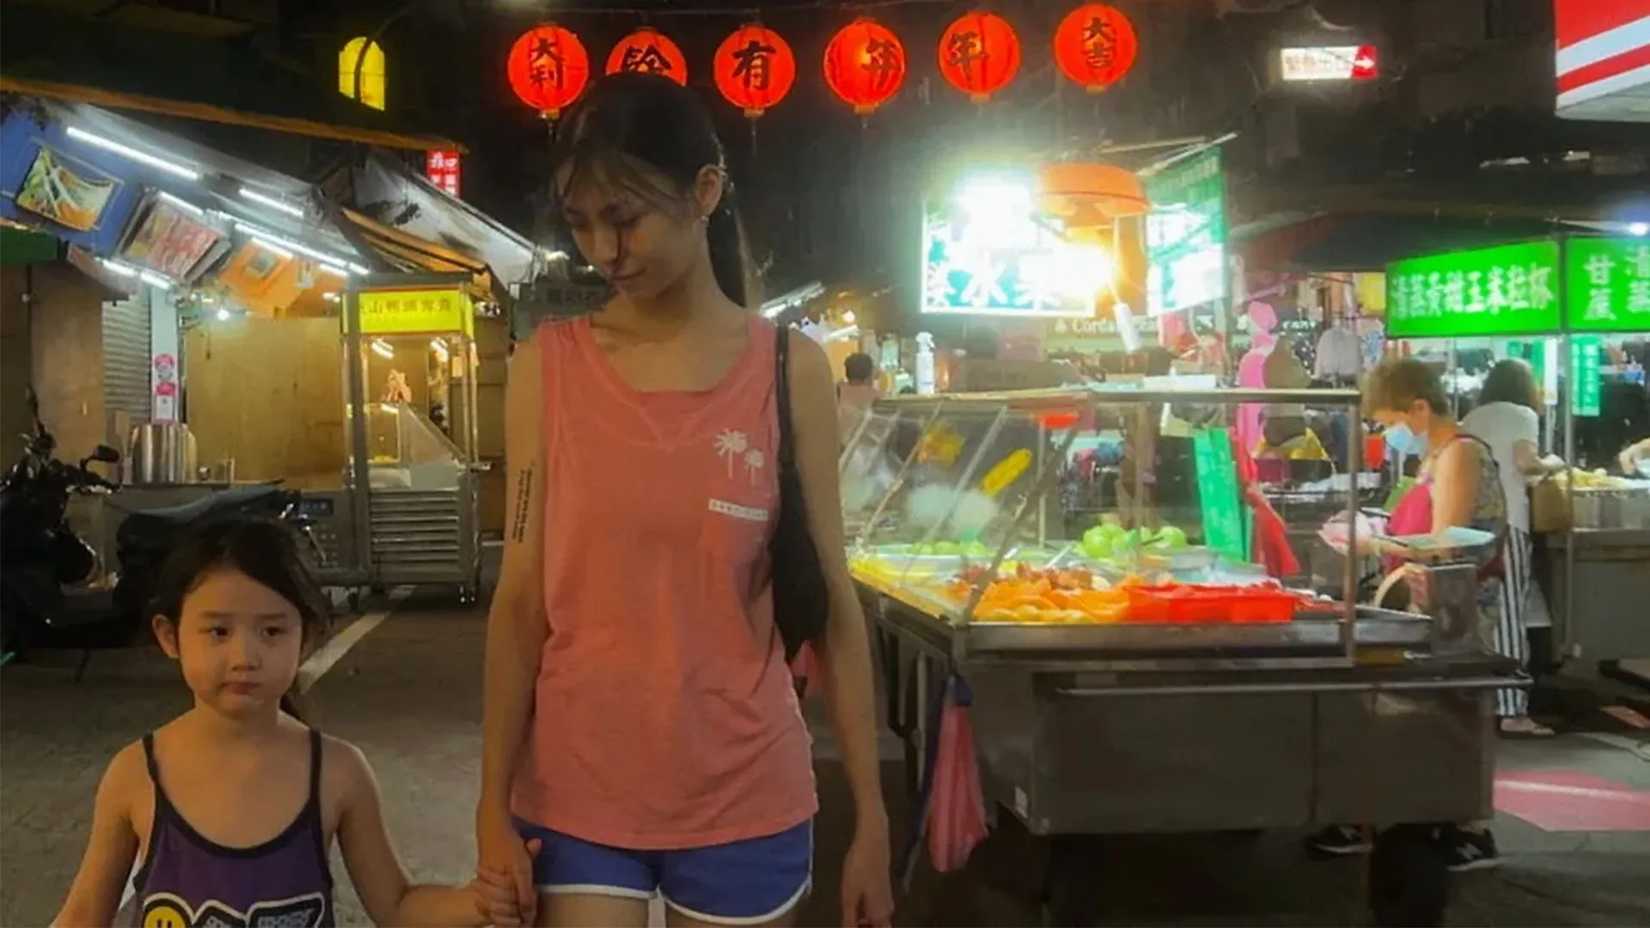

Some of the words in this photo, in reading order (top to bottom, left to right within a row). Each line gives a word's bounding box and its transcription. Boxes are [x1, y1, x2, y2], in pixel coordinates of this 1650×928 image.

[530, 38, 564, 89] 大利
[732, 40, 777, 90] 有
[861, 38, 902, 89] 年
[948, 31, 988, 89] 年
[1082, 17, 1117, 69] 大吉
